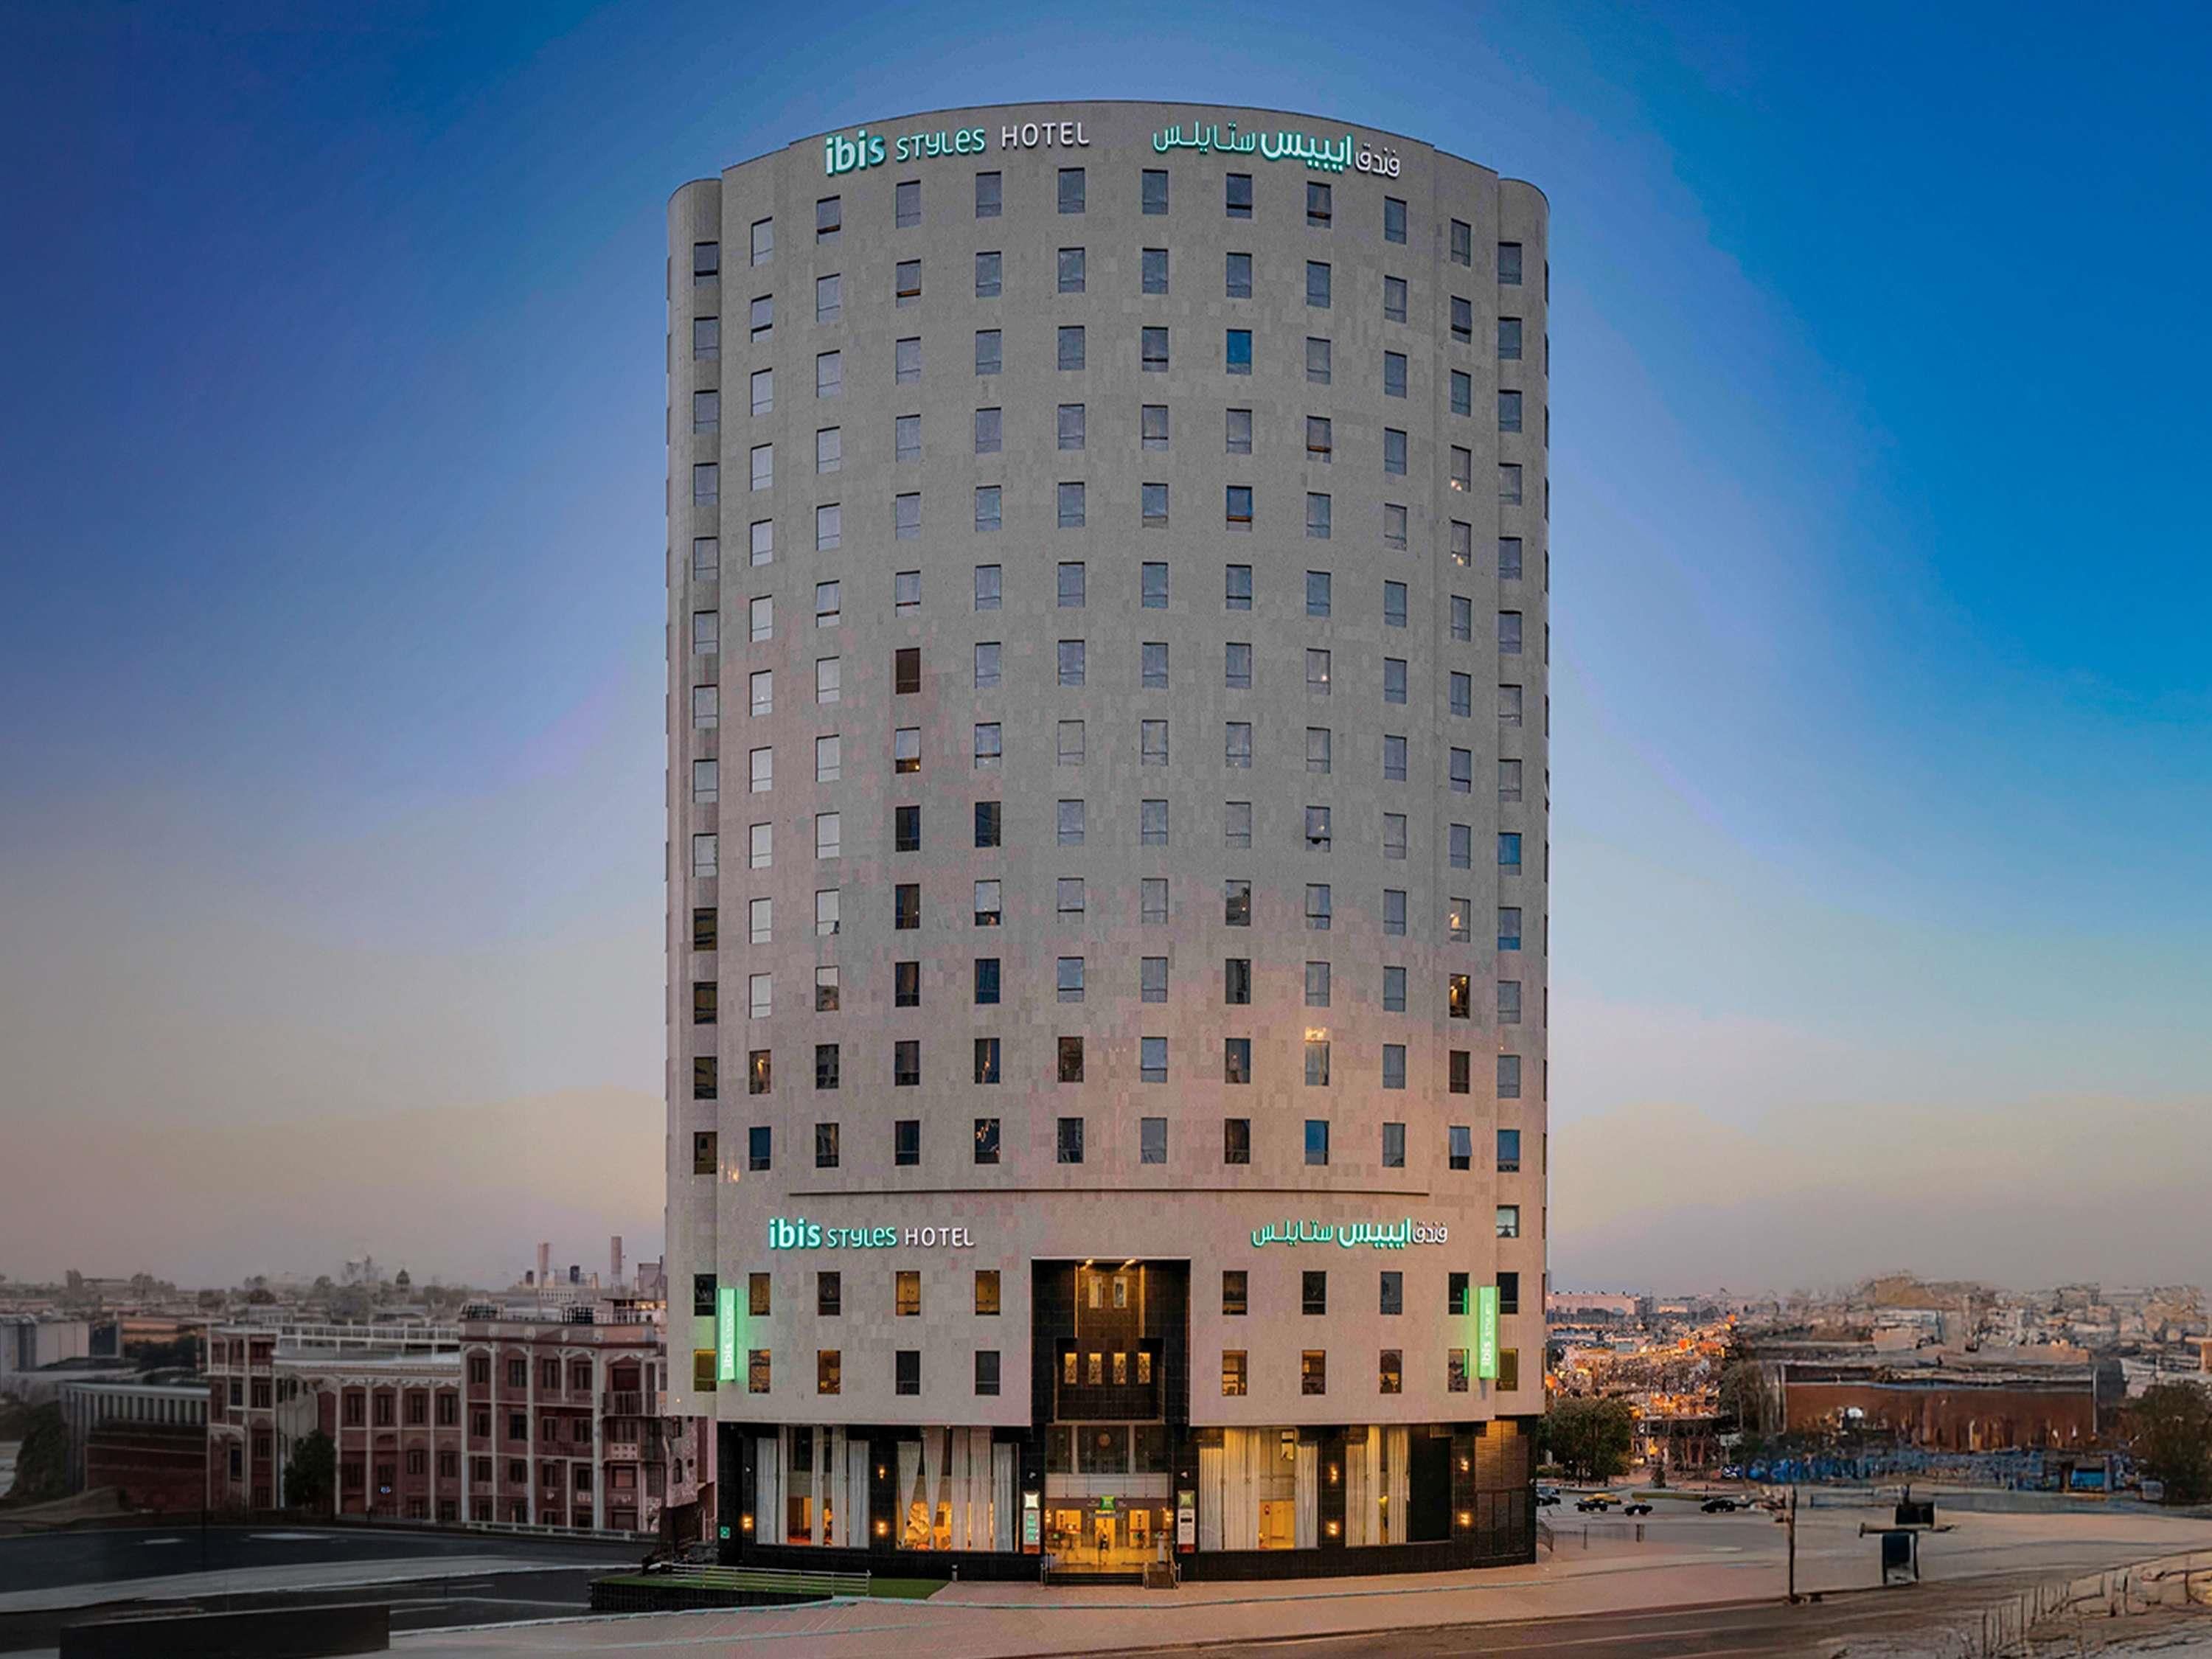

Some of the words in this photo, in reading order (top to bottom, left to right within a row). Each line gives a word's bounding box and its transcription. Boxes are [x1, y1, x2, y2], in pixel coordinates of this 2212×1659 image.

[824, 130, 886, 176] ibis
[1001, 122, 1091, 148] HOTEL
[1152, 120, 1256, 155] ستايلس
[1260, 133, 1354, 174] ايبيس
[1354, 142, 1402, 178] فندق
[768, 1217, 822, 1250] ibis
[905, 1226, 975, 1248] HOTEL
[1251, 1218, 1334, 1247] ستايلس
[1337, 1217, 1412, 1249] ايبيس
[1412, 1220, 1448, 1244] فندق
